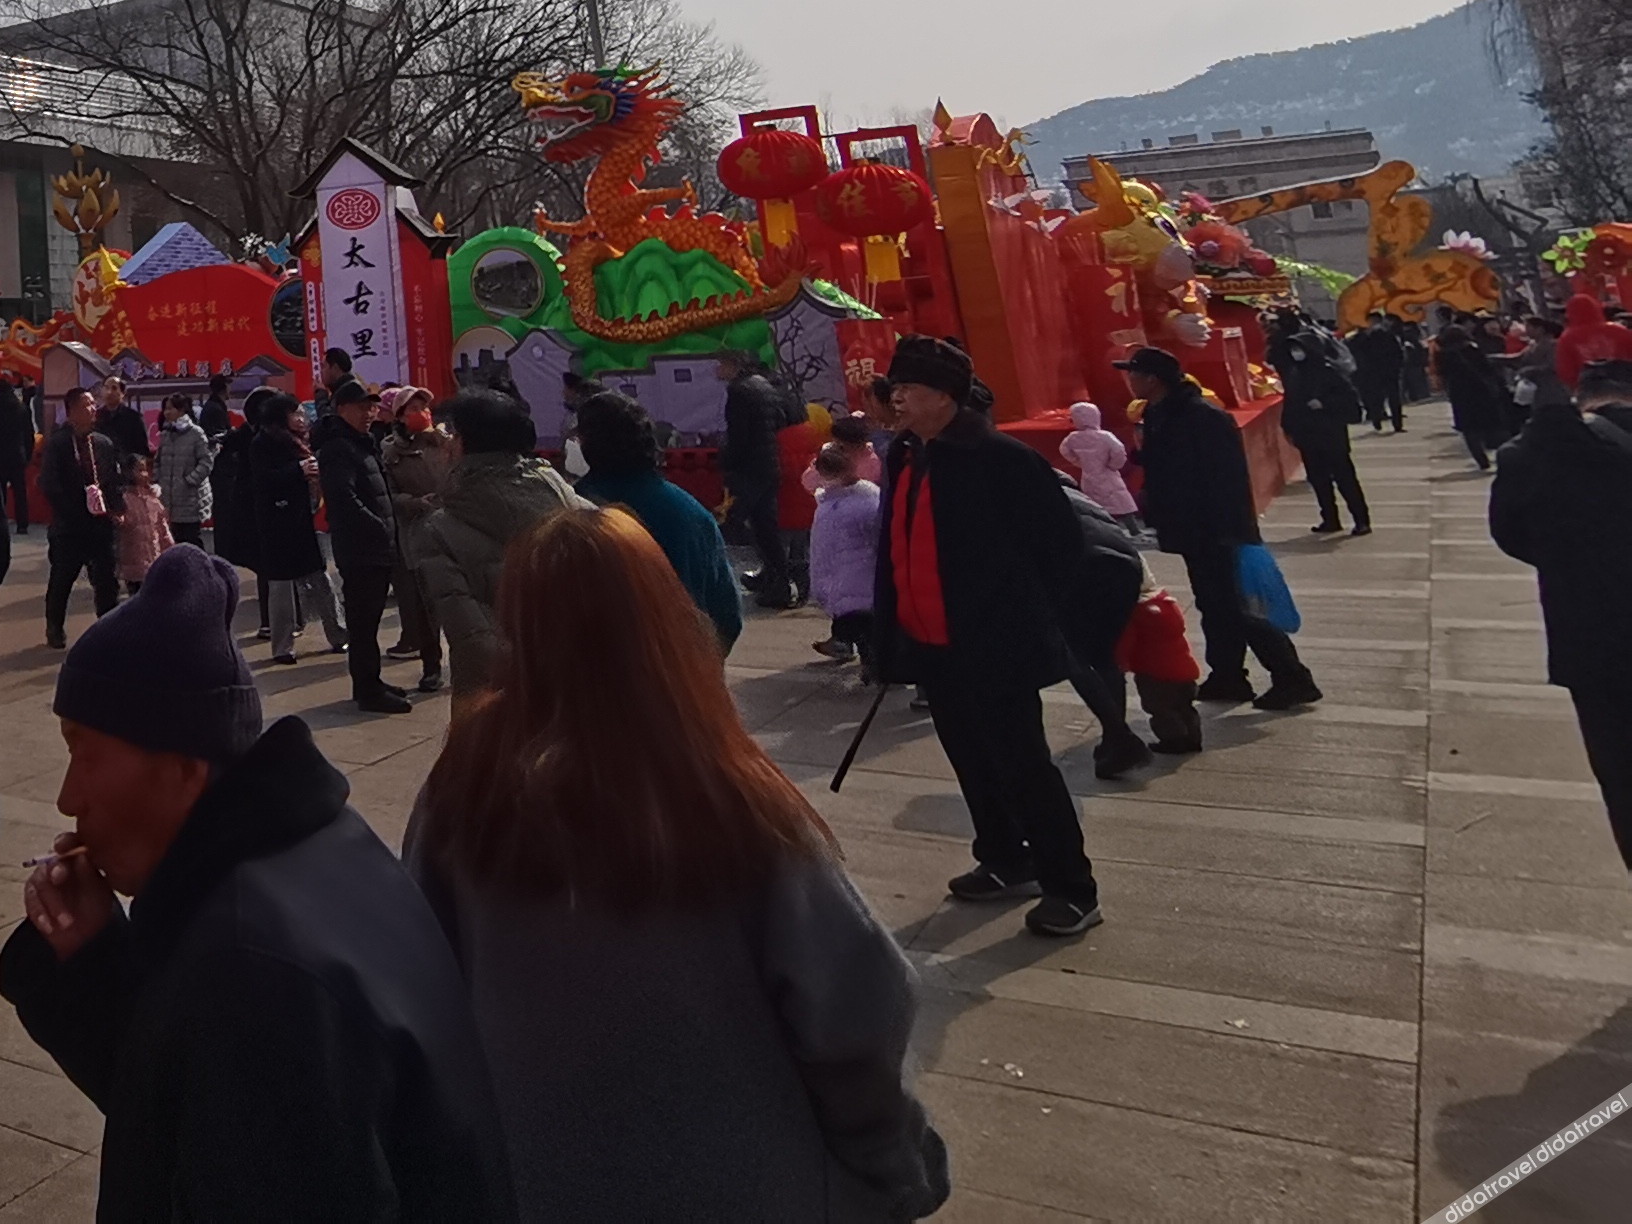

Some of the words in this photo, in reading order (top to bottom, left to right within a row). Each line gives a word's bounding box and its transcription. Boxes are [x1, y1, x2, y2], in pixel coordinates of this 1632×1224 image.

[342, 237, 377, 359] 太古里
[147, 300, 218, 321] 奋进新征程
[177, 316, 250, 336] 建功新时代
